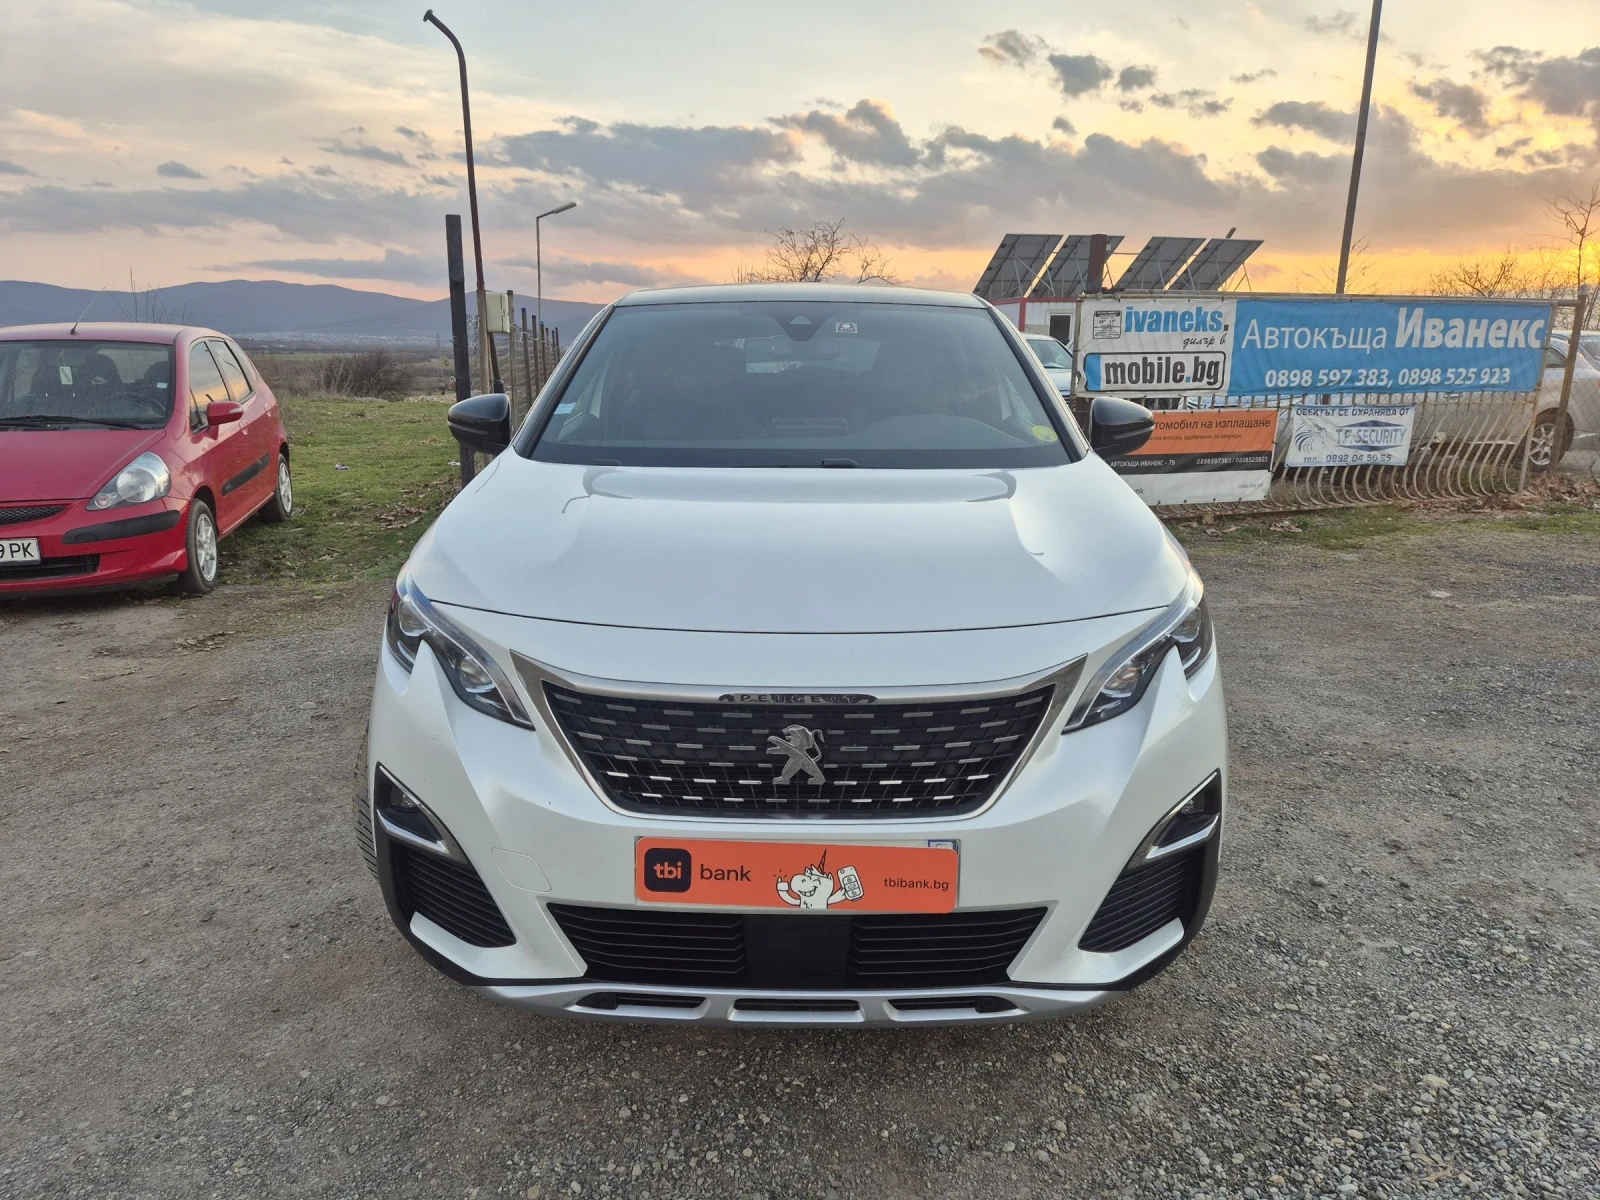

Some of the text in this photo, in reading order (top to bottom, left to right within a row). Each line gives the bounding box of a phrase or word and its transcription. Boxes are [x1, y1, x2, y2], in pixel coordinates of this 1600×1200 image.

[1125, 306, 1229, 333] ivaneks.
[1242, 307, 1545, 354] Автокъща Иванекс
[1105, 356, 1220, 386] mobile.bg
[1265, 367, 1511, 389] 0898 597 383, 0898 525 923
[1338, 408, 1349, 417] СЕ
[1351, 408, 1397, 416] ОХРАНЯВА
[1399, 407, 1410, 416] ОТ
[1154, 418, 1271, 430] томобил на изплащане
[1354, 428, 1407, 444] SECURITY
[1325, 454, 1349, 463] 0892
[1352, 454, 1364, 462] 04
[1366, 454, 1378, 462] 50
[9, 542, 34, 558] PK
[740, 693, 856, 704] PEUGEOT
[653, 861, 949, 891] tbi bank tbibank.bg
